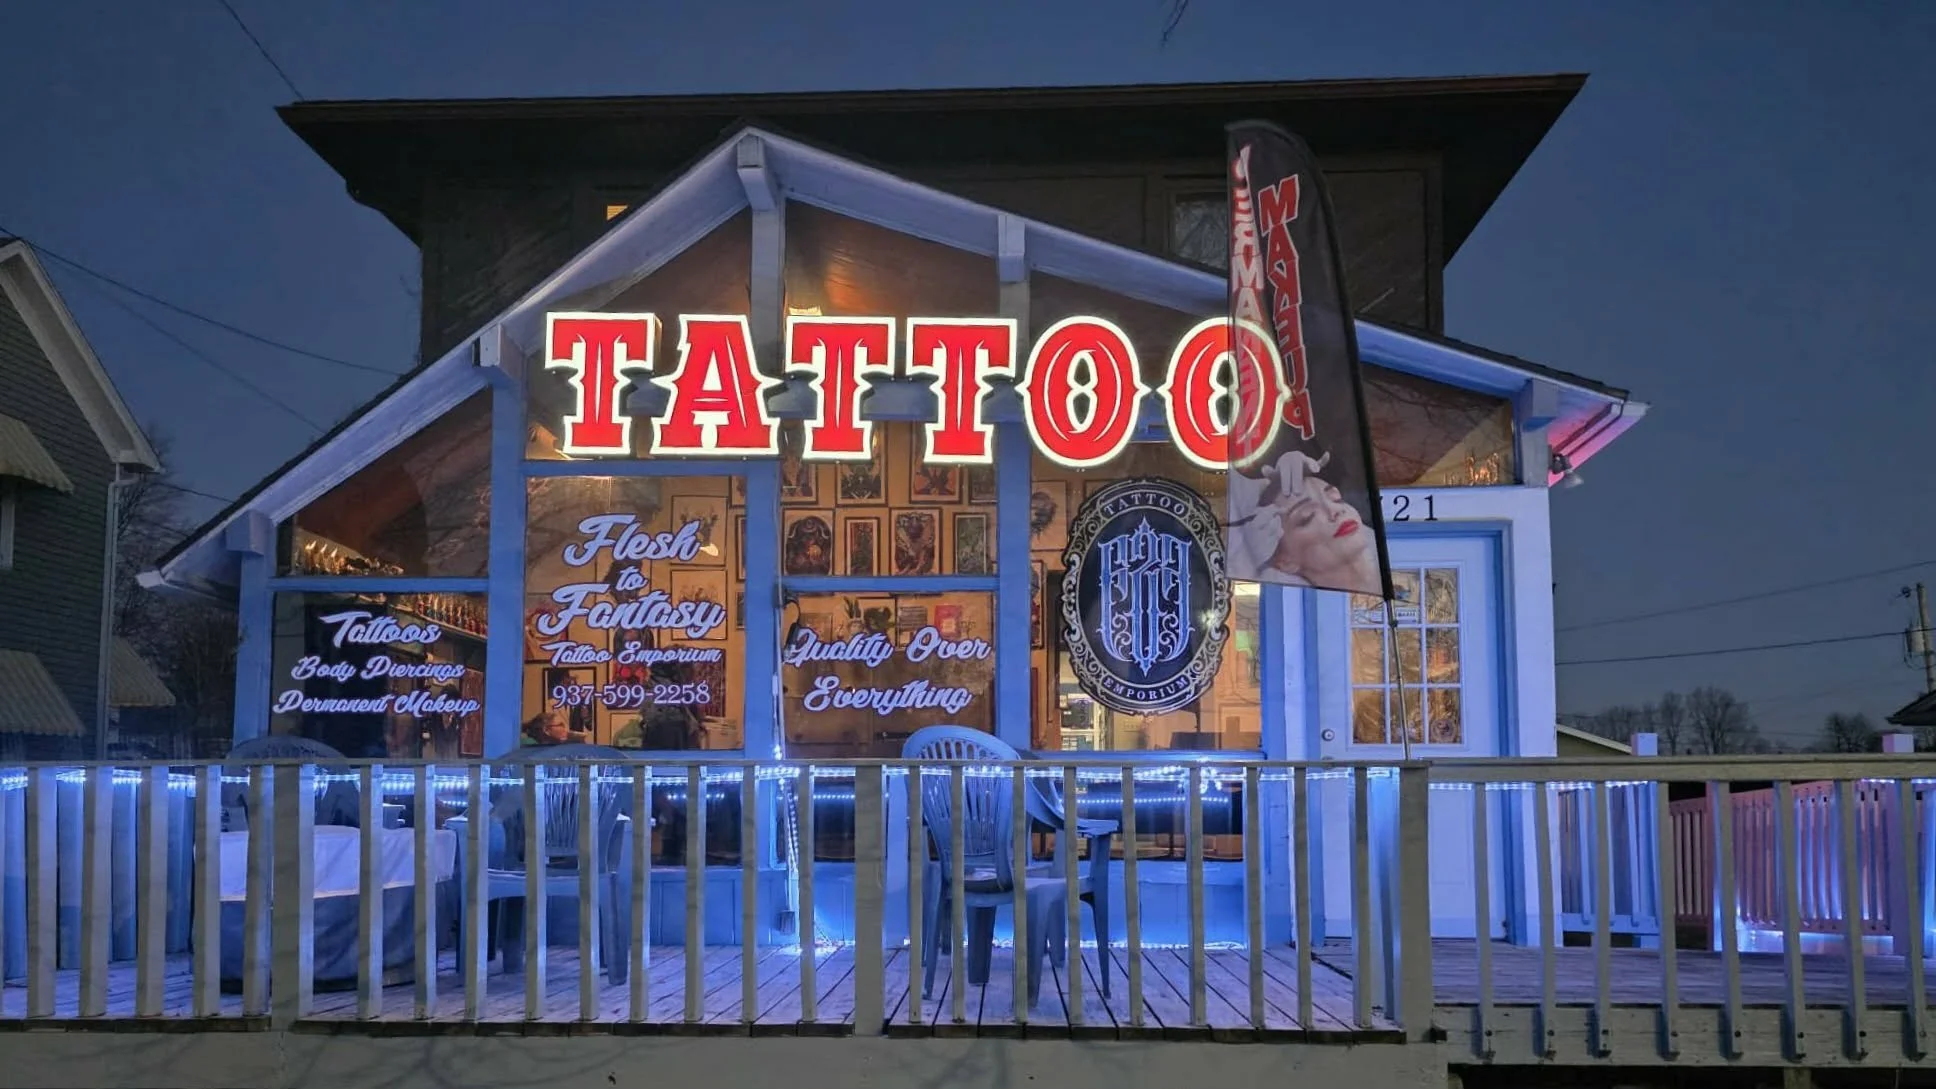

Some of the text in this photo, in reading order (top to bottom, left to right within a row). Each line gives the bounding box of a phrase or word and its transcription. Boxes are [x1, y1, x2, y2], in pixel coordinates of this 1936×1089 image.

[544, 311, 1292, 471] TATTOO
[1103, 493, 1186, 516] TATTOO
[564, 514, 701, 566] Flesh
[615, 565, 648, 591] to
[537, 583, 727, 638] Fantasy
[319, 611, 442, 648] Tattoos
[542, 641, 722, 666] Tattoo Emporium
[784, 625, 992, 668] Quality Over
[290, 656, 357, 683] Body
[552, 680, 711, 708] 937-599-2258
[803, 676, 973, 715] Everything
[1103, 676, 1188, 700] EMPORIUM
[394, 690, 481, 718] Makeup
